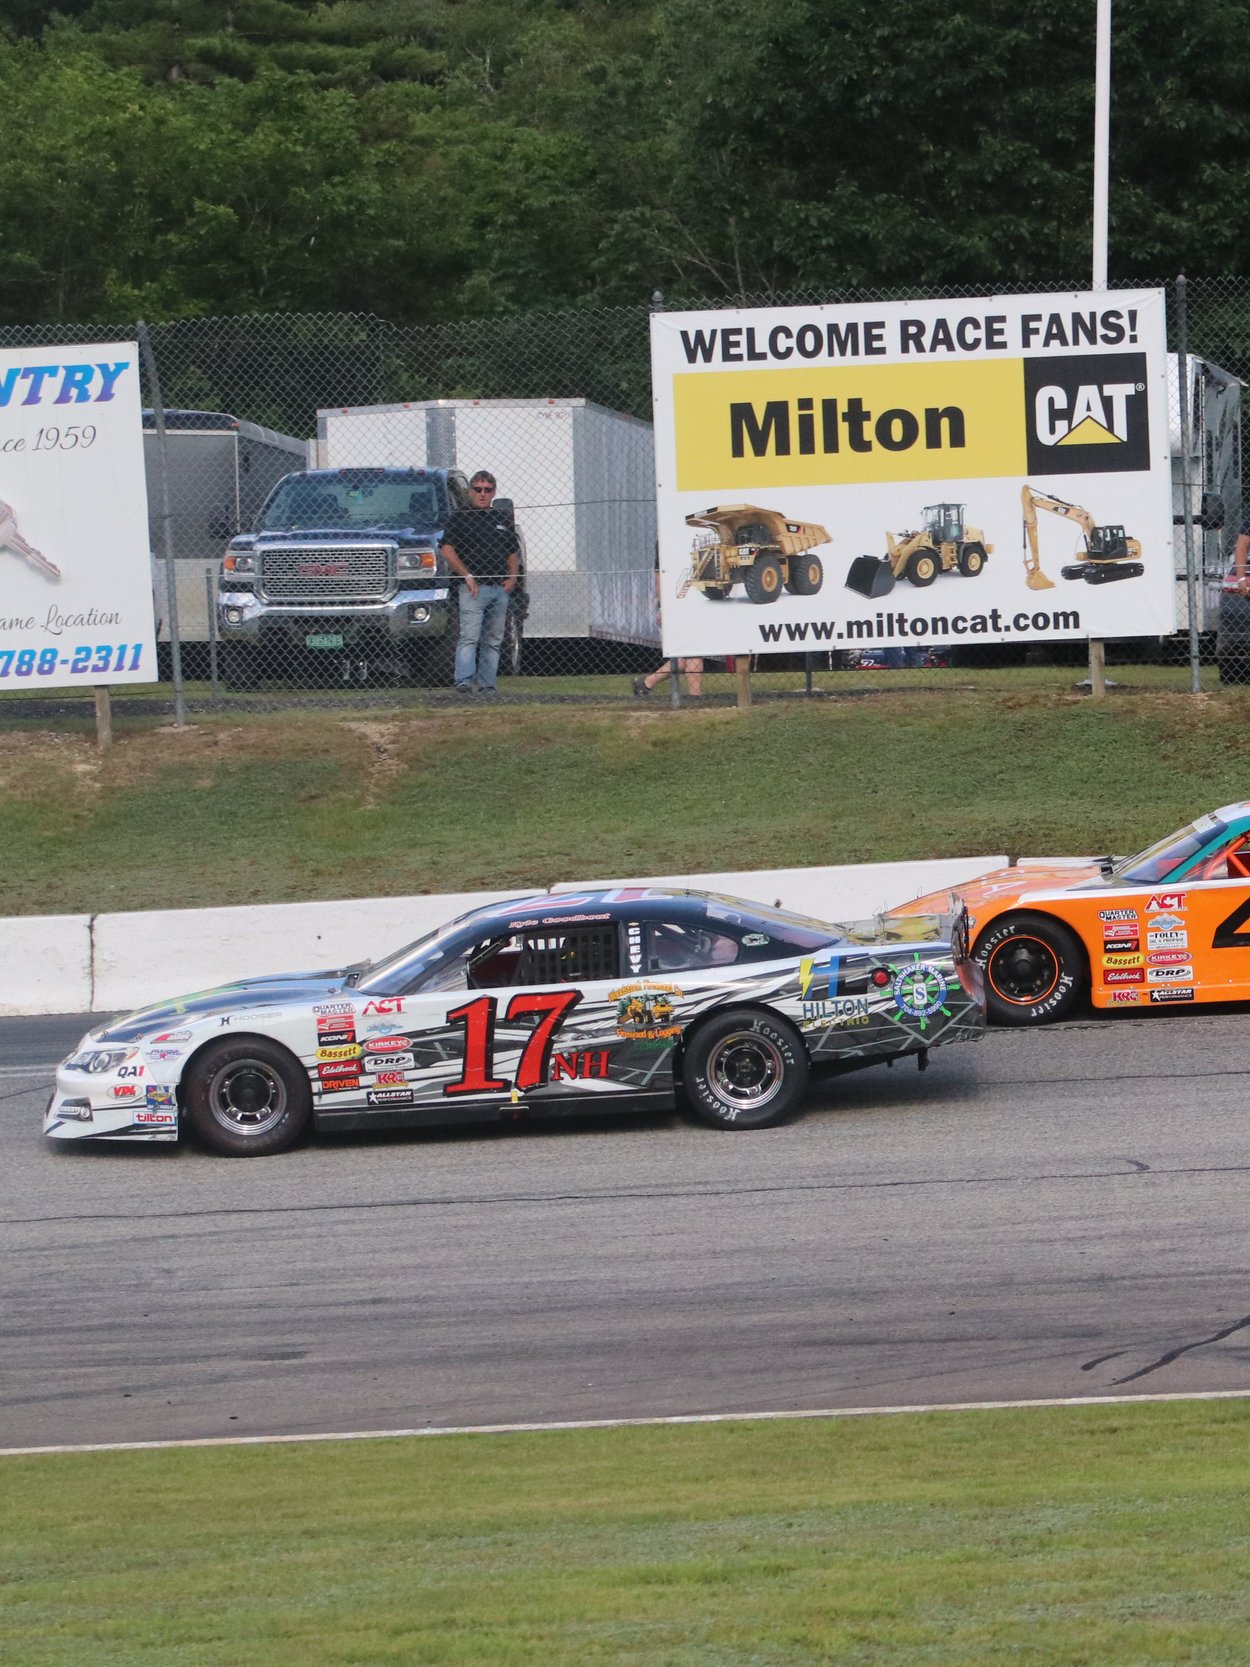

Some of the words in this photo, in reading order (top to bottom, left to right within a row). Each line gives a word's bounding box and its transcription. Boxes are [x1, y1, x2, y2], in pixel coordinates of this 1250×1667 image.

[680, 320, 888, 364] WELCOME
[900, 314, 1008, 354] RACE
[1020, 308, 1140, 349] FANS!
[729, 396, 967, 459] Milton
[32, 425, 97, 451] 1959
[39, 603, 124, 636] Location
[758, 608, 1081, 644] www.miltoncat.com
[1099, 909, 1134, 919] QUARTER
[628, 927, 641, 974] CHEVY
[975, 925, 1016, 970] Hoosier
[1106, 955, 1141, 965] Bassett
[893, 963, 926, 995] SALTSHAKER
[926, 964, 947, 992] MARINE
[1107, 972, 1142, 981] Edelbrock
[1155, 969, 1186, 977] DRP
[915, 987, 926, 1001] S
[1031, 972, 1074, 1017] Hoosier
[1112, 991, 1138, 1002] KRC
[313, 1002, 351, 1013] QUARTER
[320, 1006, 356, 1016] MASTER
[802, 998, 869, 1020] HILTON
[319, 1034, 349, 1042] KONI
[615, 1027, 648, 1039] Firewood
[647, 1030, 655, 1039] &
[655, 1024, 683, 1037] Logging
[368, 1040, 402, 1048] KIRKEY
[443, 988, 585, 1097] 17
[748, 1019, 795, 1065] Hoosier
[320, 1046, 357, 1058] Bassett
[373, 1056, 406, 1066] DRP
[549, 1050, 611, 1082] NH
[117, 1065, 145, 1079] QA1
[322, 1064, 358, 1075] Edelbrock
[322, 1079, 360, 1090] DRIVEN
[376, 1071, 405, 1085] KRC
[695, 1076, 742, 1121] Hoosier
[135, 1113, 173, 1123] tilton
